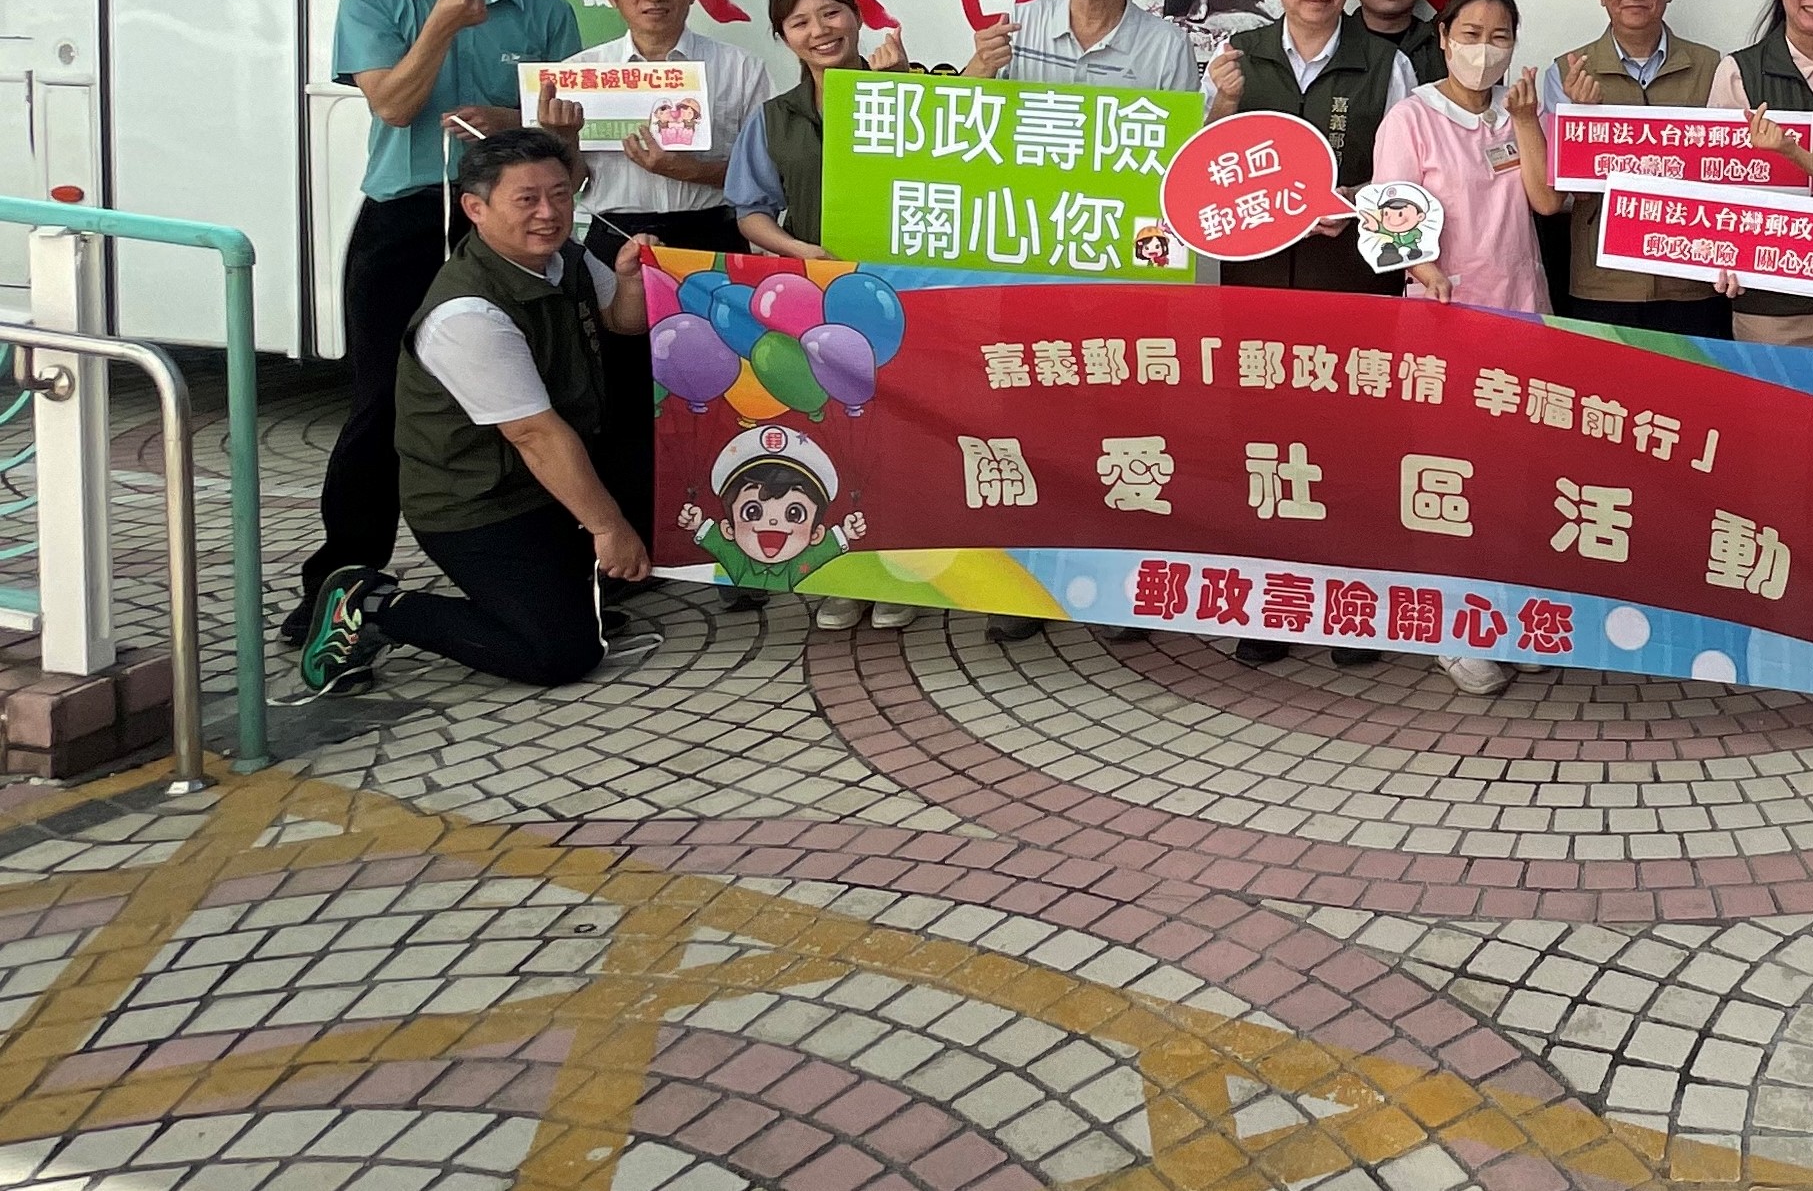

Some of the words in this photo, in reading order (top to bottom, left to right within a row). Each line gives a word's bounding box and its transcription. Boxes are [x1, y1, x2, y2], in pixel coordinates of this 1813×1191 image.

[852, 80, 1169, 176] 郵政壽險
[1207, 139, 1282, 187] 捐血
[1594, 154, 1685, 179] 郵政壽險
[1699, 157, 1771, 183] 關心您
[889, 180, 1126, 272] 關心您
[1199, 180, 1307, 241] 郵愛心
[1642, 233, 1739, 267] 郵政壽險
[1473, 365, 1720, 475] 幸福前行」
[958, 435, 1792, 601] 關愛社區活動
[1132, 559, 1576, 655] 郵政壽險關心您
